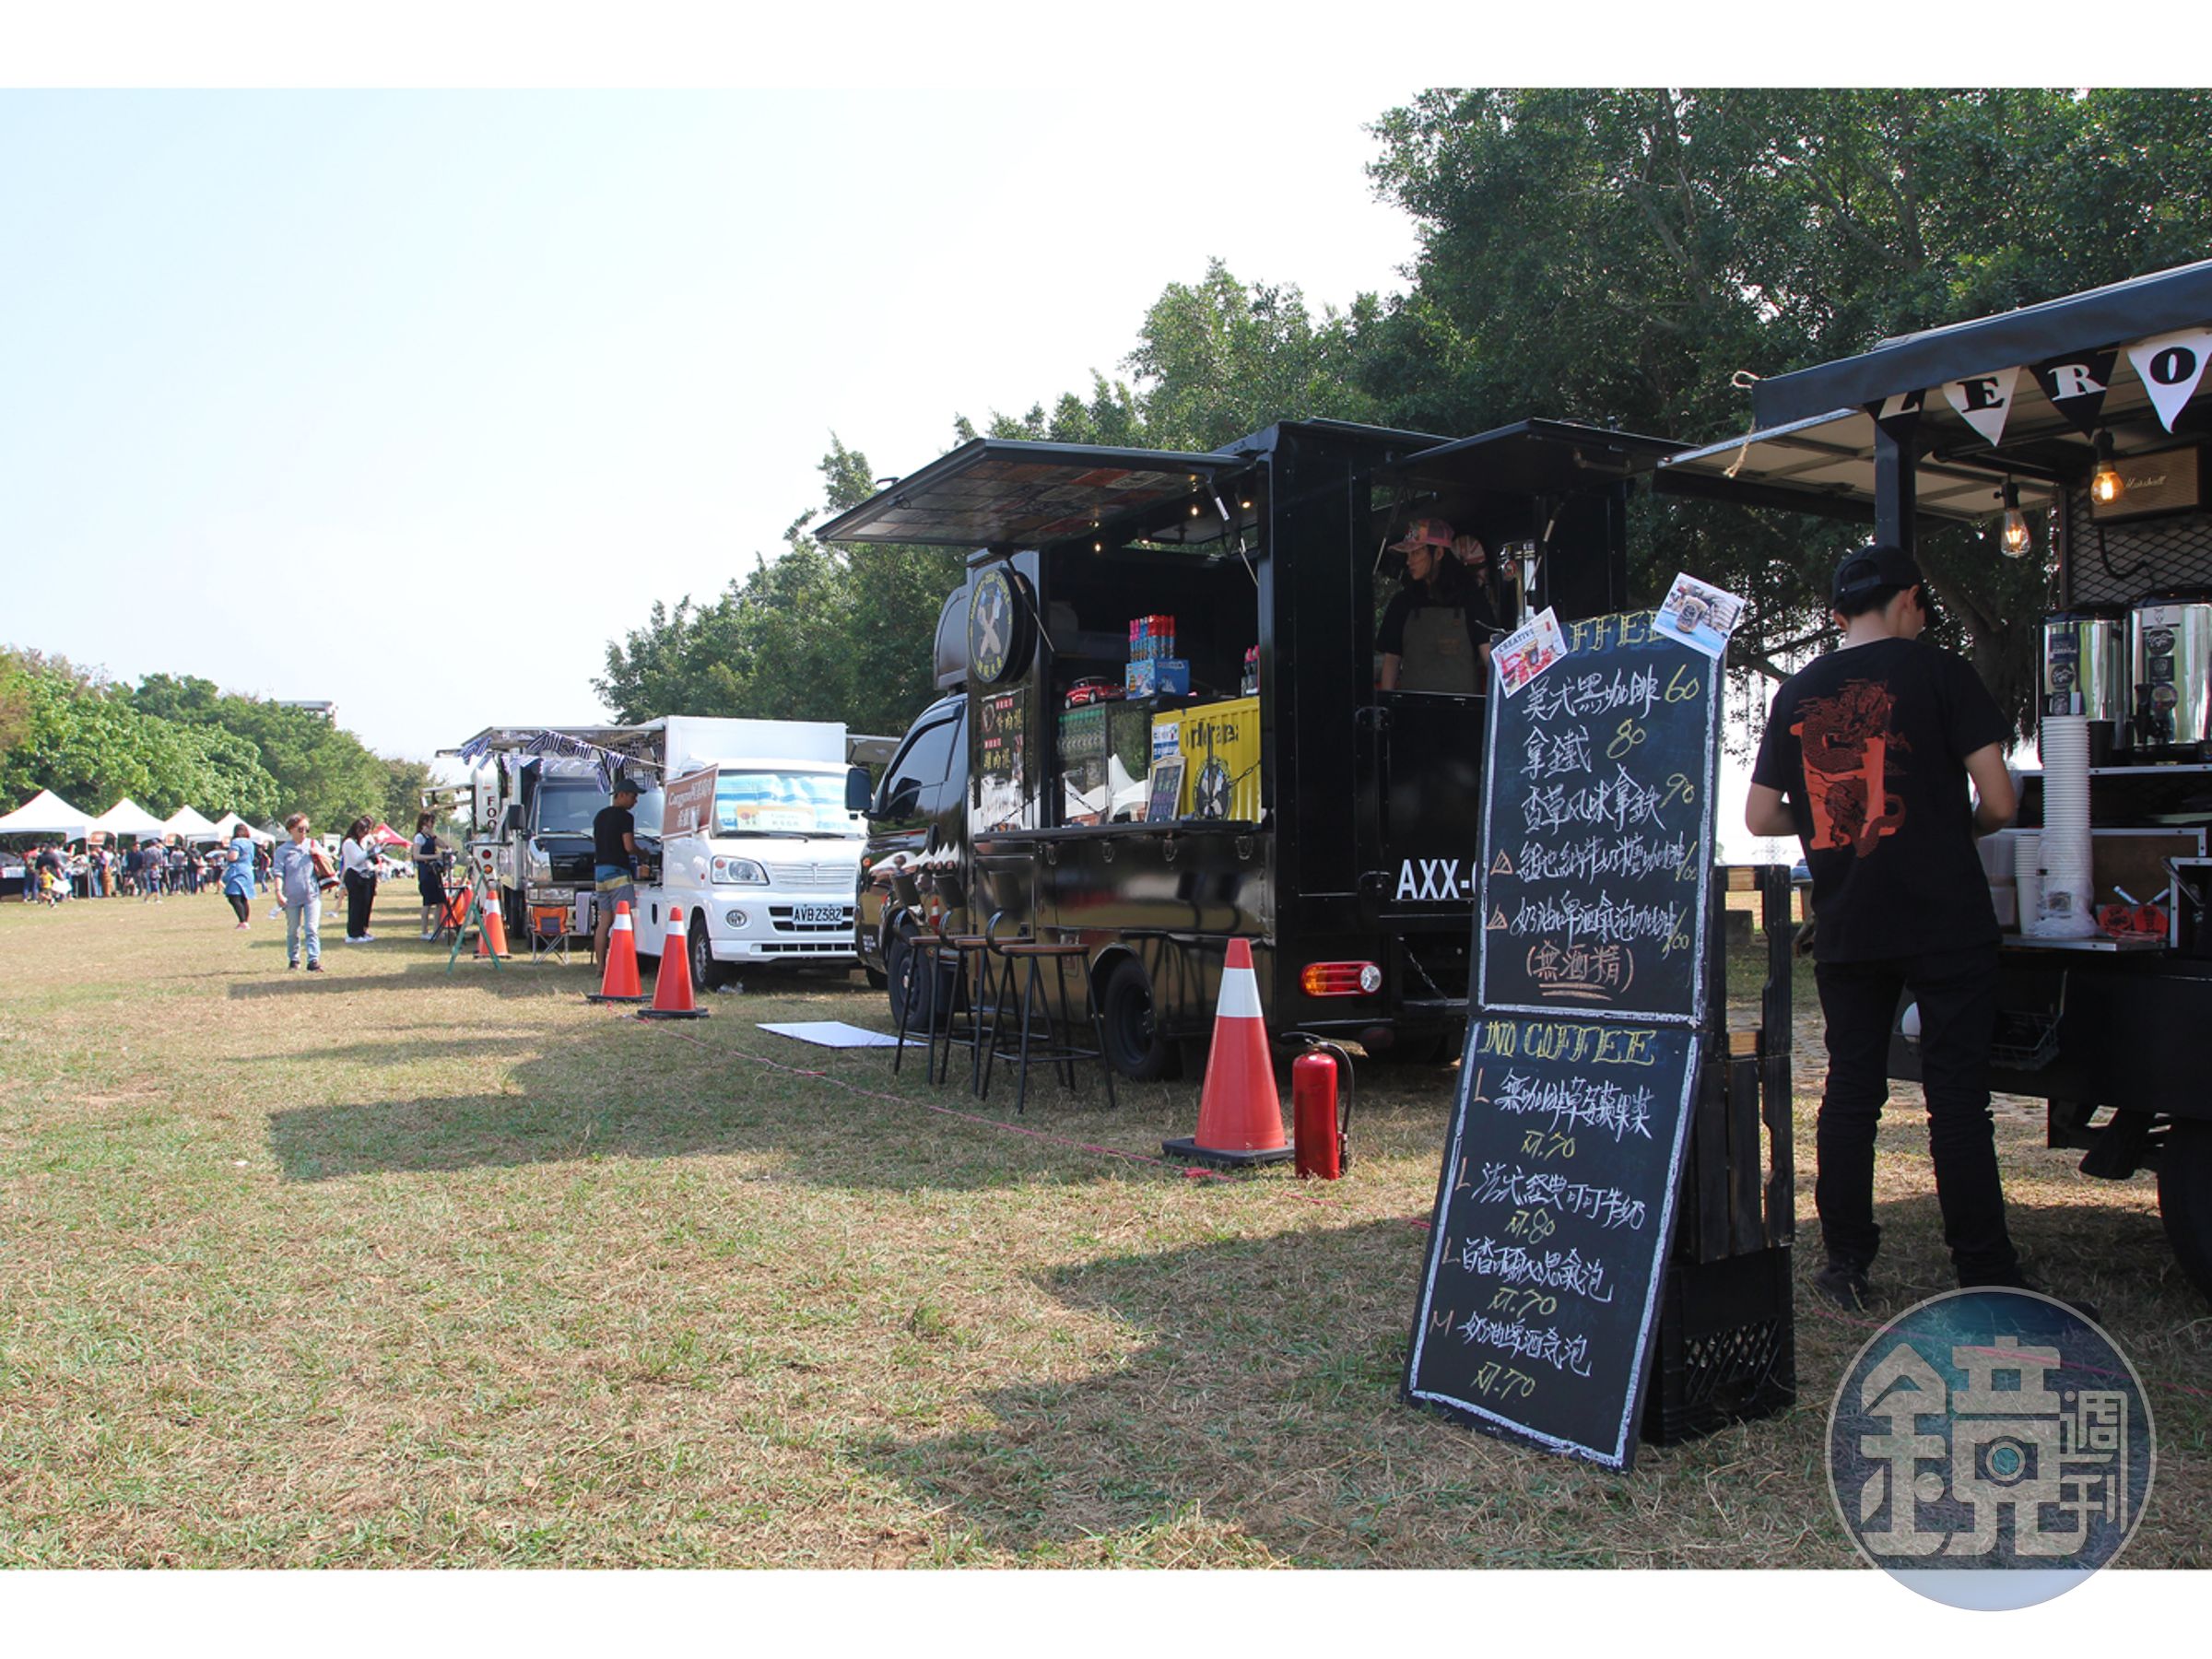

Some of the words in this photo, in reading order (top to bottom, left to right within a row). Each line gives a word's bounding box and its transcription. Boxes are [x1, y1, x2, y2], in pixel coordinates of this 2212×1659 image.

[1569, 610, 1667, 652] FFEE
[1523, 665, 1660, 722] 美式黑咖啡
[1664, 664, 1700, 703] 60
[1606, 718, 1647, 759] 80
[1659, 772, 1695, 809] 90
[487, 795, 498, 830] FOO
[1395, 859, 1477, 900] AXX-
[1477, 1020, 1516, 1057] NO
[1524, 1023, 1657, 1065] COFFEE
